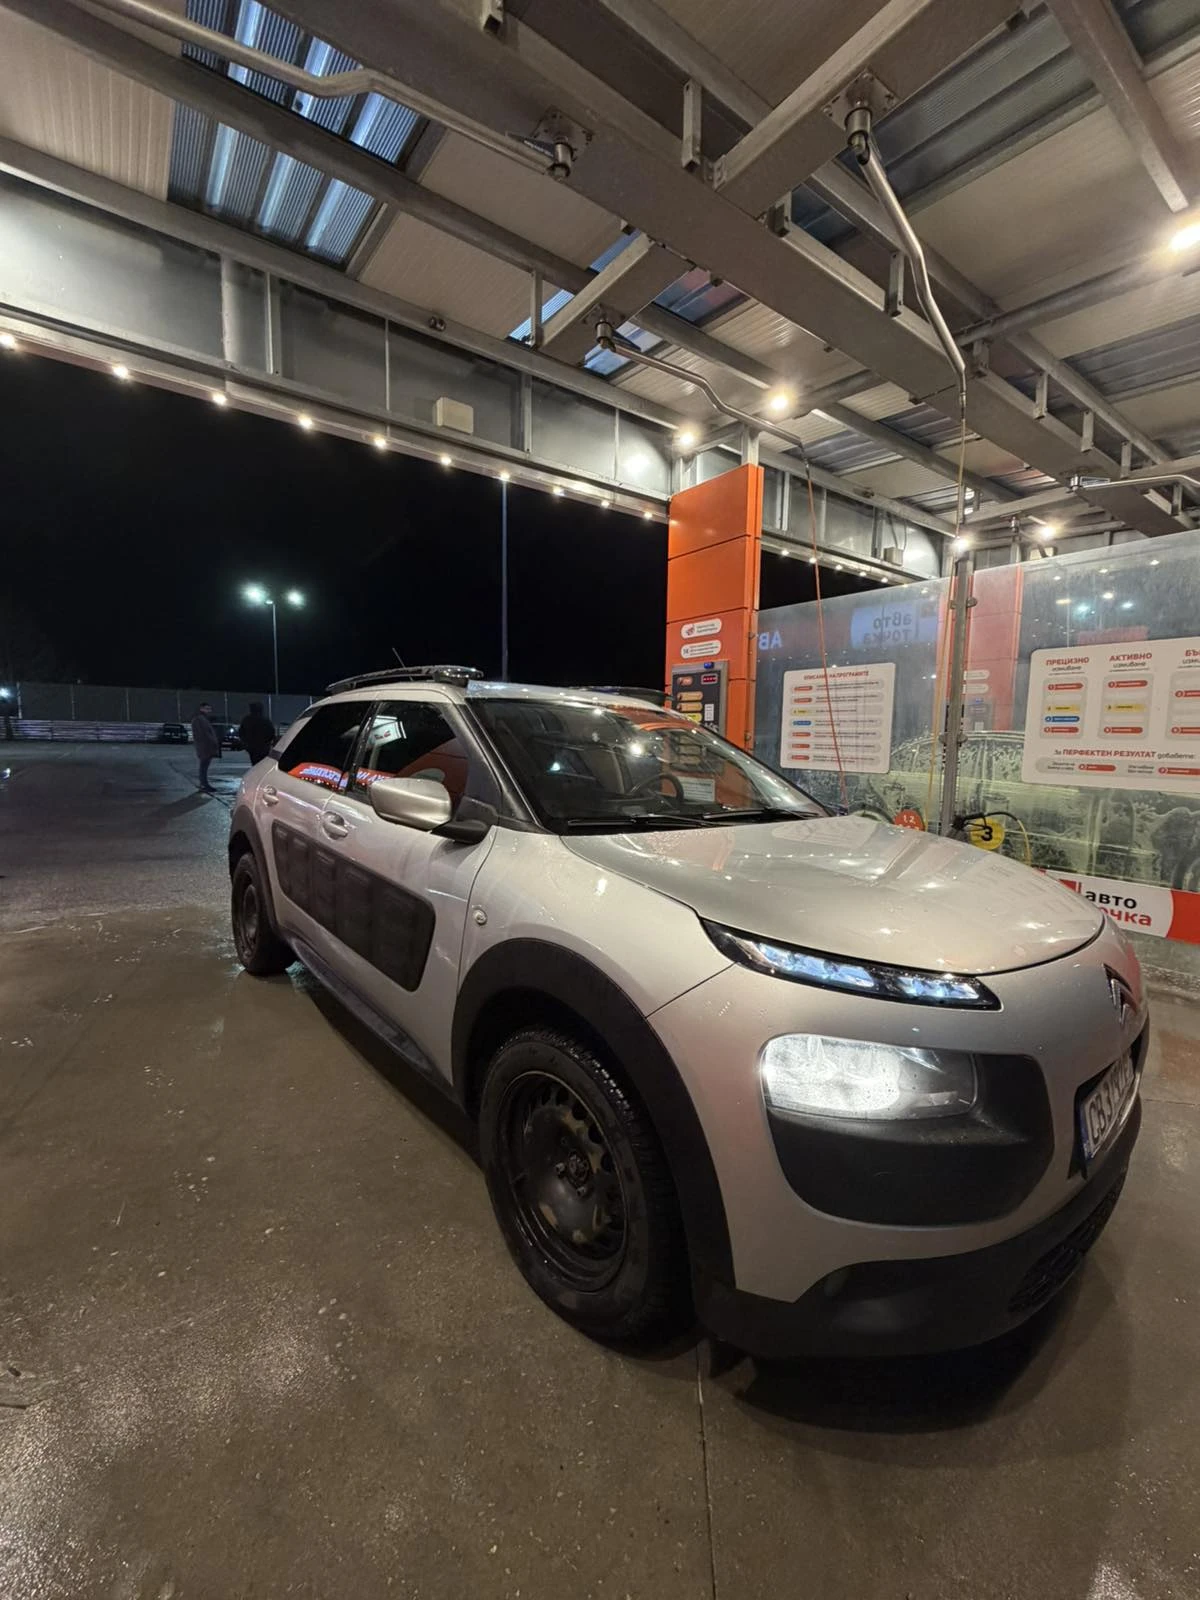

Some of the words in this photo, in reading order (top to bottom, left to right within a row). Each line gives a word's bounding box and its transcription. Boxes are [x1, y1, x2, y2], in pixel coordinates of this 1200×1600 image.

[1046, 656, 1090, 666] ПРЕЦИЗНО
[1109, 652, 1153, 662] АКТИВНО
[1063, 748, 1112, 757] ПЕРФЕКТЕН
[1113, 750, 1157, 758] РЕЗУЛТАТ
[981, 826, 993, 841] 3
[1085, 891, 1137, 910] авто
